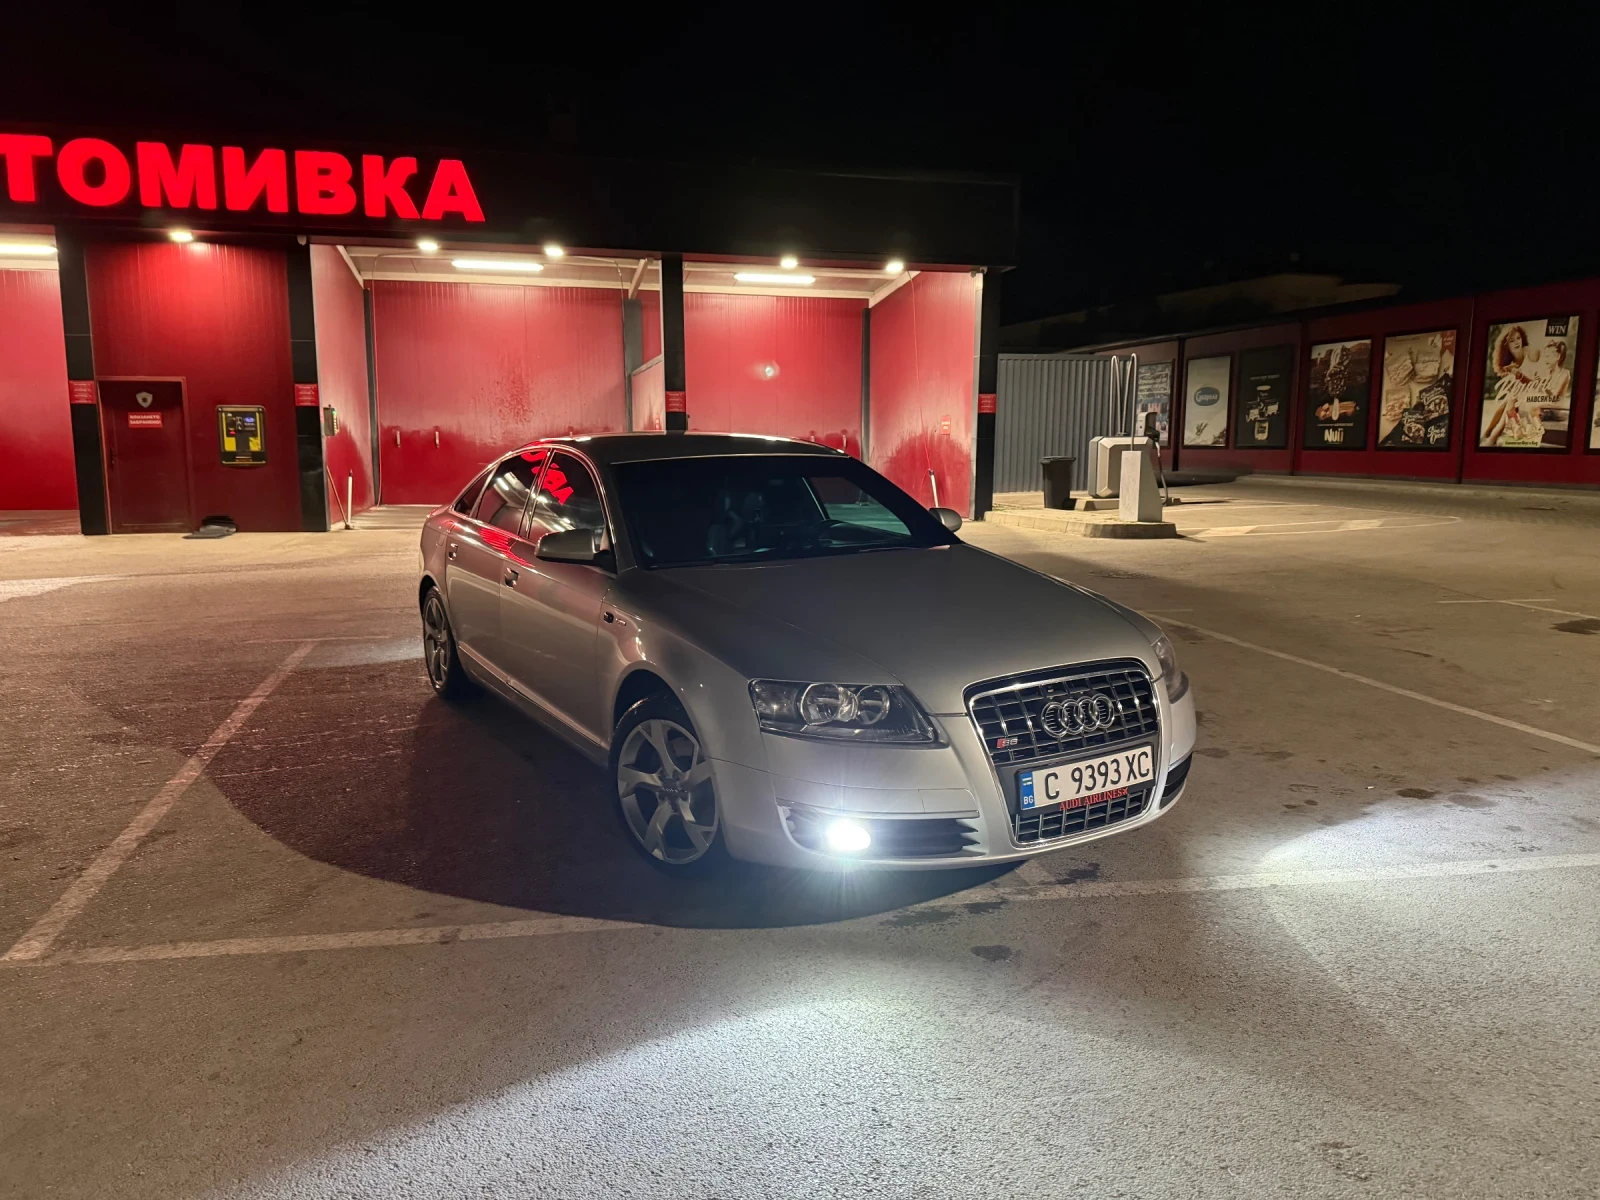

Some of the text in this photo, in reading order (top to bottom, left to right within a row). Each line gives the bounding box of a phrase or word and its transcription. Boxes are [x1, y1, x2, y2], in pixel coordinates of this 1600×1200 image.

[0, 134, 486, 222] ТОМИВКА
[1044, 772, 1060, 800] C
[1070, 758, 1122, 794] 9393
[1023, 795, 1034, 805] BG
[1060, 788, 1122, 811] AUDI AIRLINES
